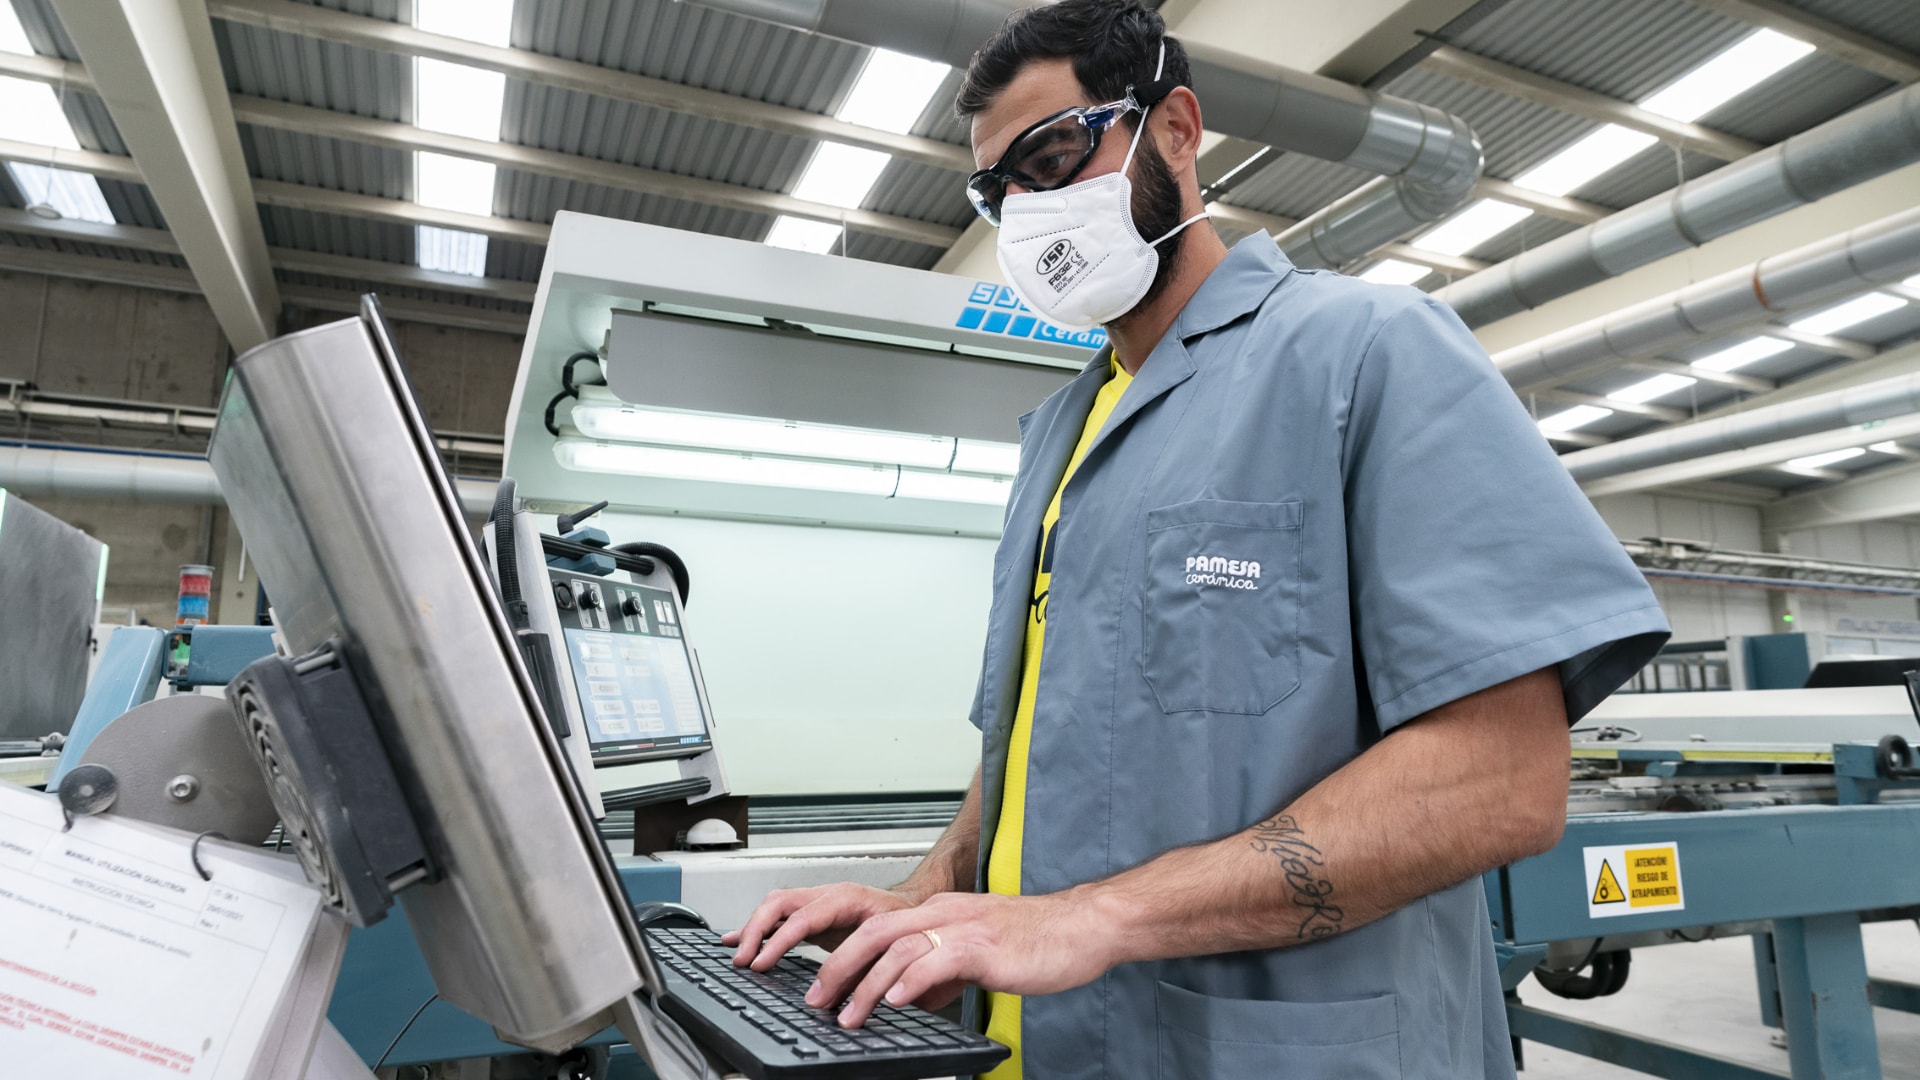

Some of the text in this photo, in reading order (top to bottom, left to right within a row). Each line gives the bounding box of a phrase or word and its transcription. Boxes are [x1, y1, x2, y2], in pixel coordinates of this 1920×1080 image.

[1042, 242, 1065, 271] JSP
[1048, 262, 1072, 286] F632
[1186, 555, 1261, 579] PAMESA
[65, 848, 96, 866] MANUAL
[1636, 871, 1669, 883] RIESGO DE
[1631, 886, 1677, 898] ATRAPAMIENTO
